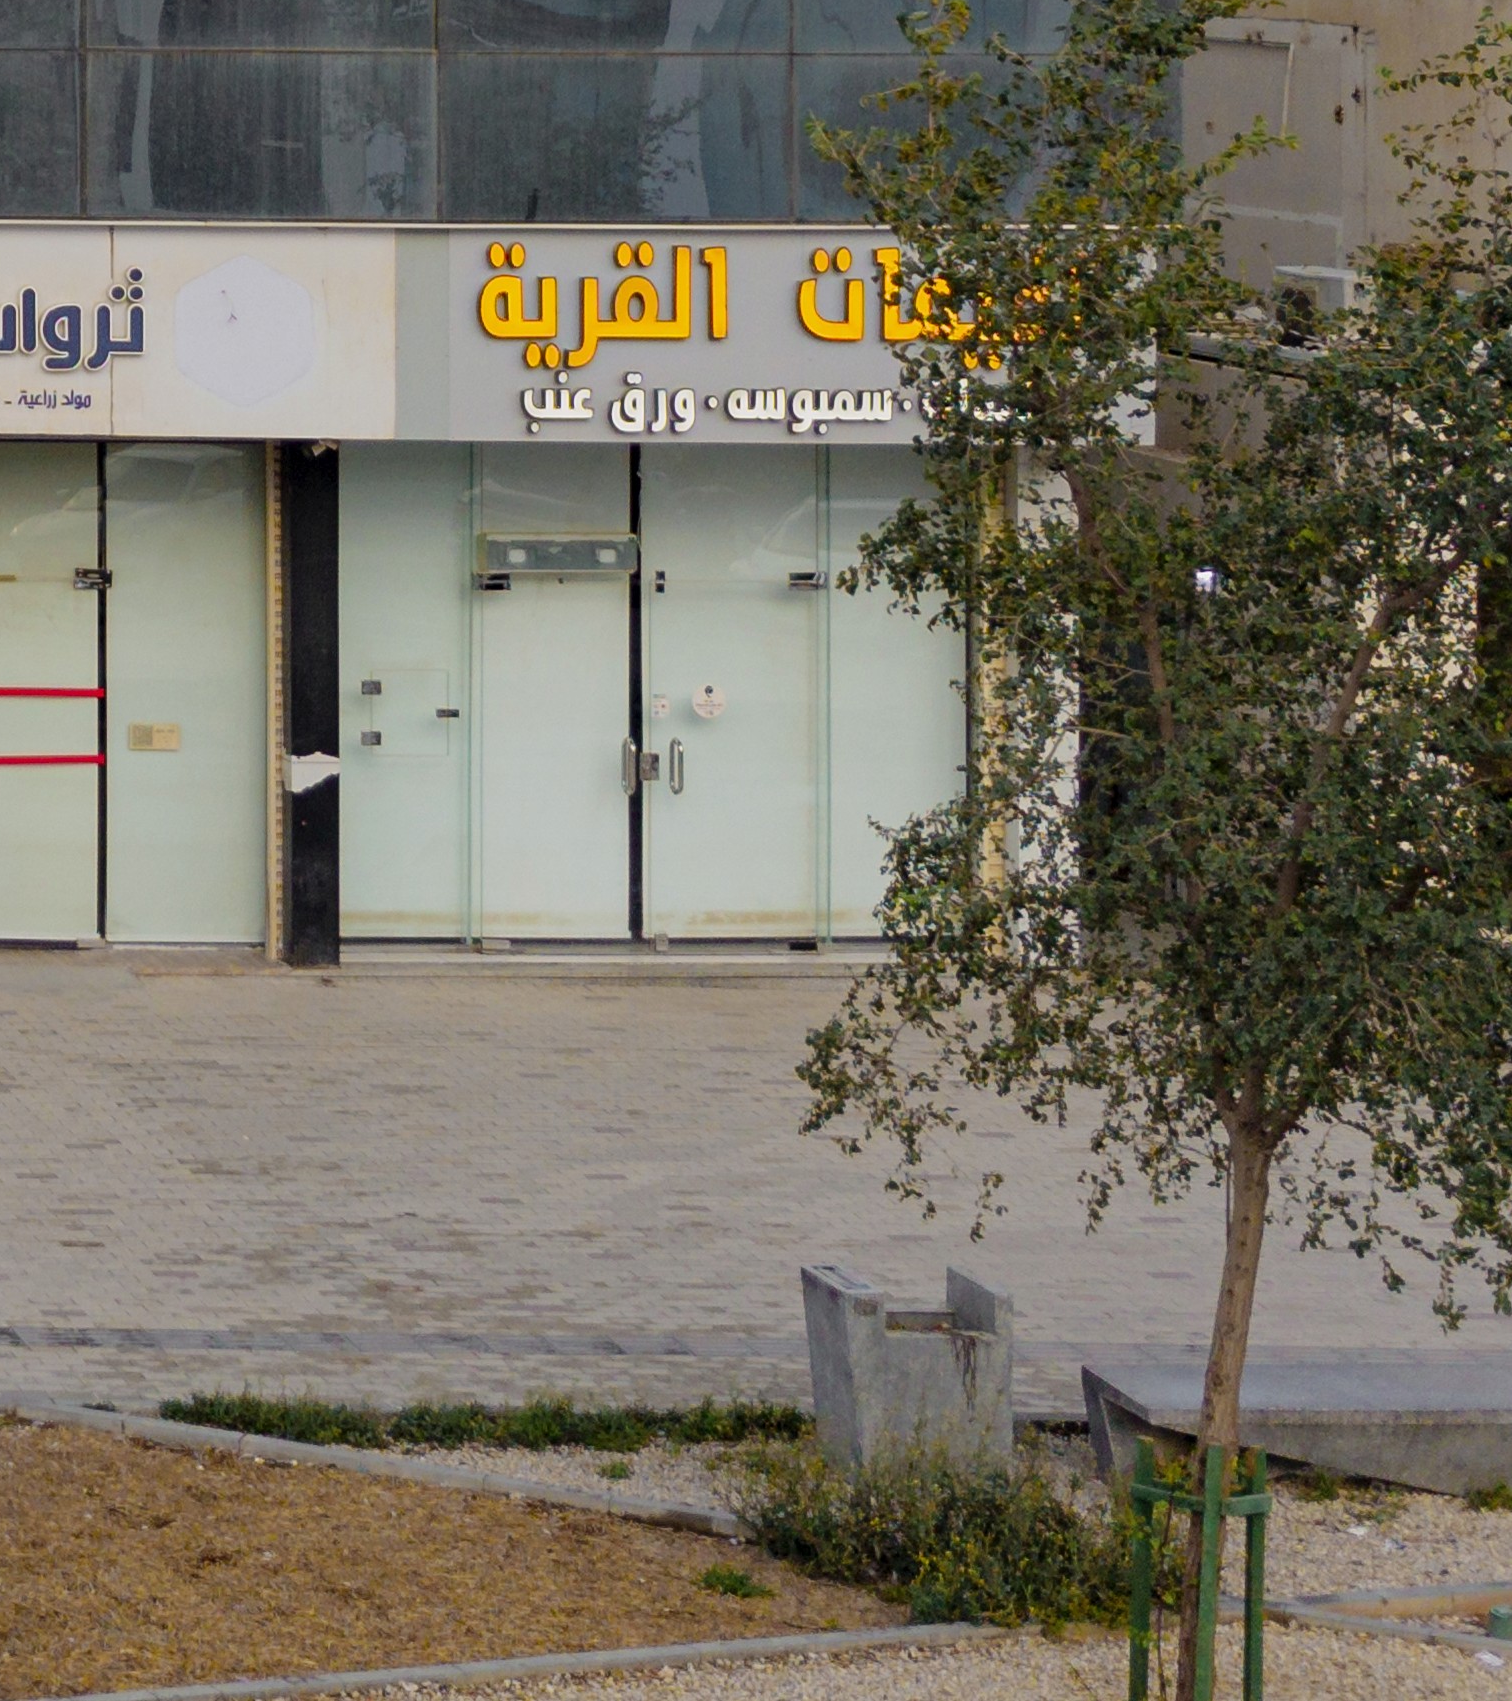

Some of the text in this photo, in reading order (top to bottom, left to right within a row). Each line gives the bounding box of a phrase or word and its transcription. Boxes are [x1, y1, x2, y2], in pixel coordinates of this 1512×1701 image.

[478, 241, 729, 369] القرية
[17, 389, 58, 410] زراعية
[521, 370, 594, 434] عنب
[609, 371, 697, 435] ورق
